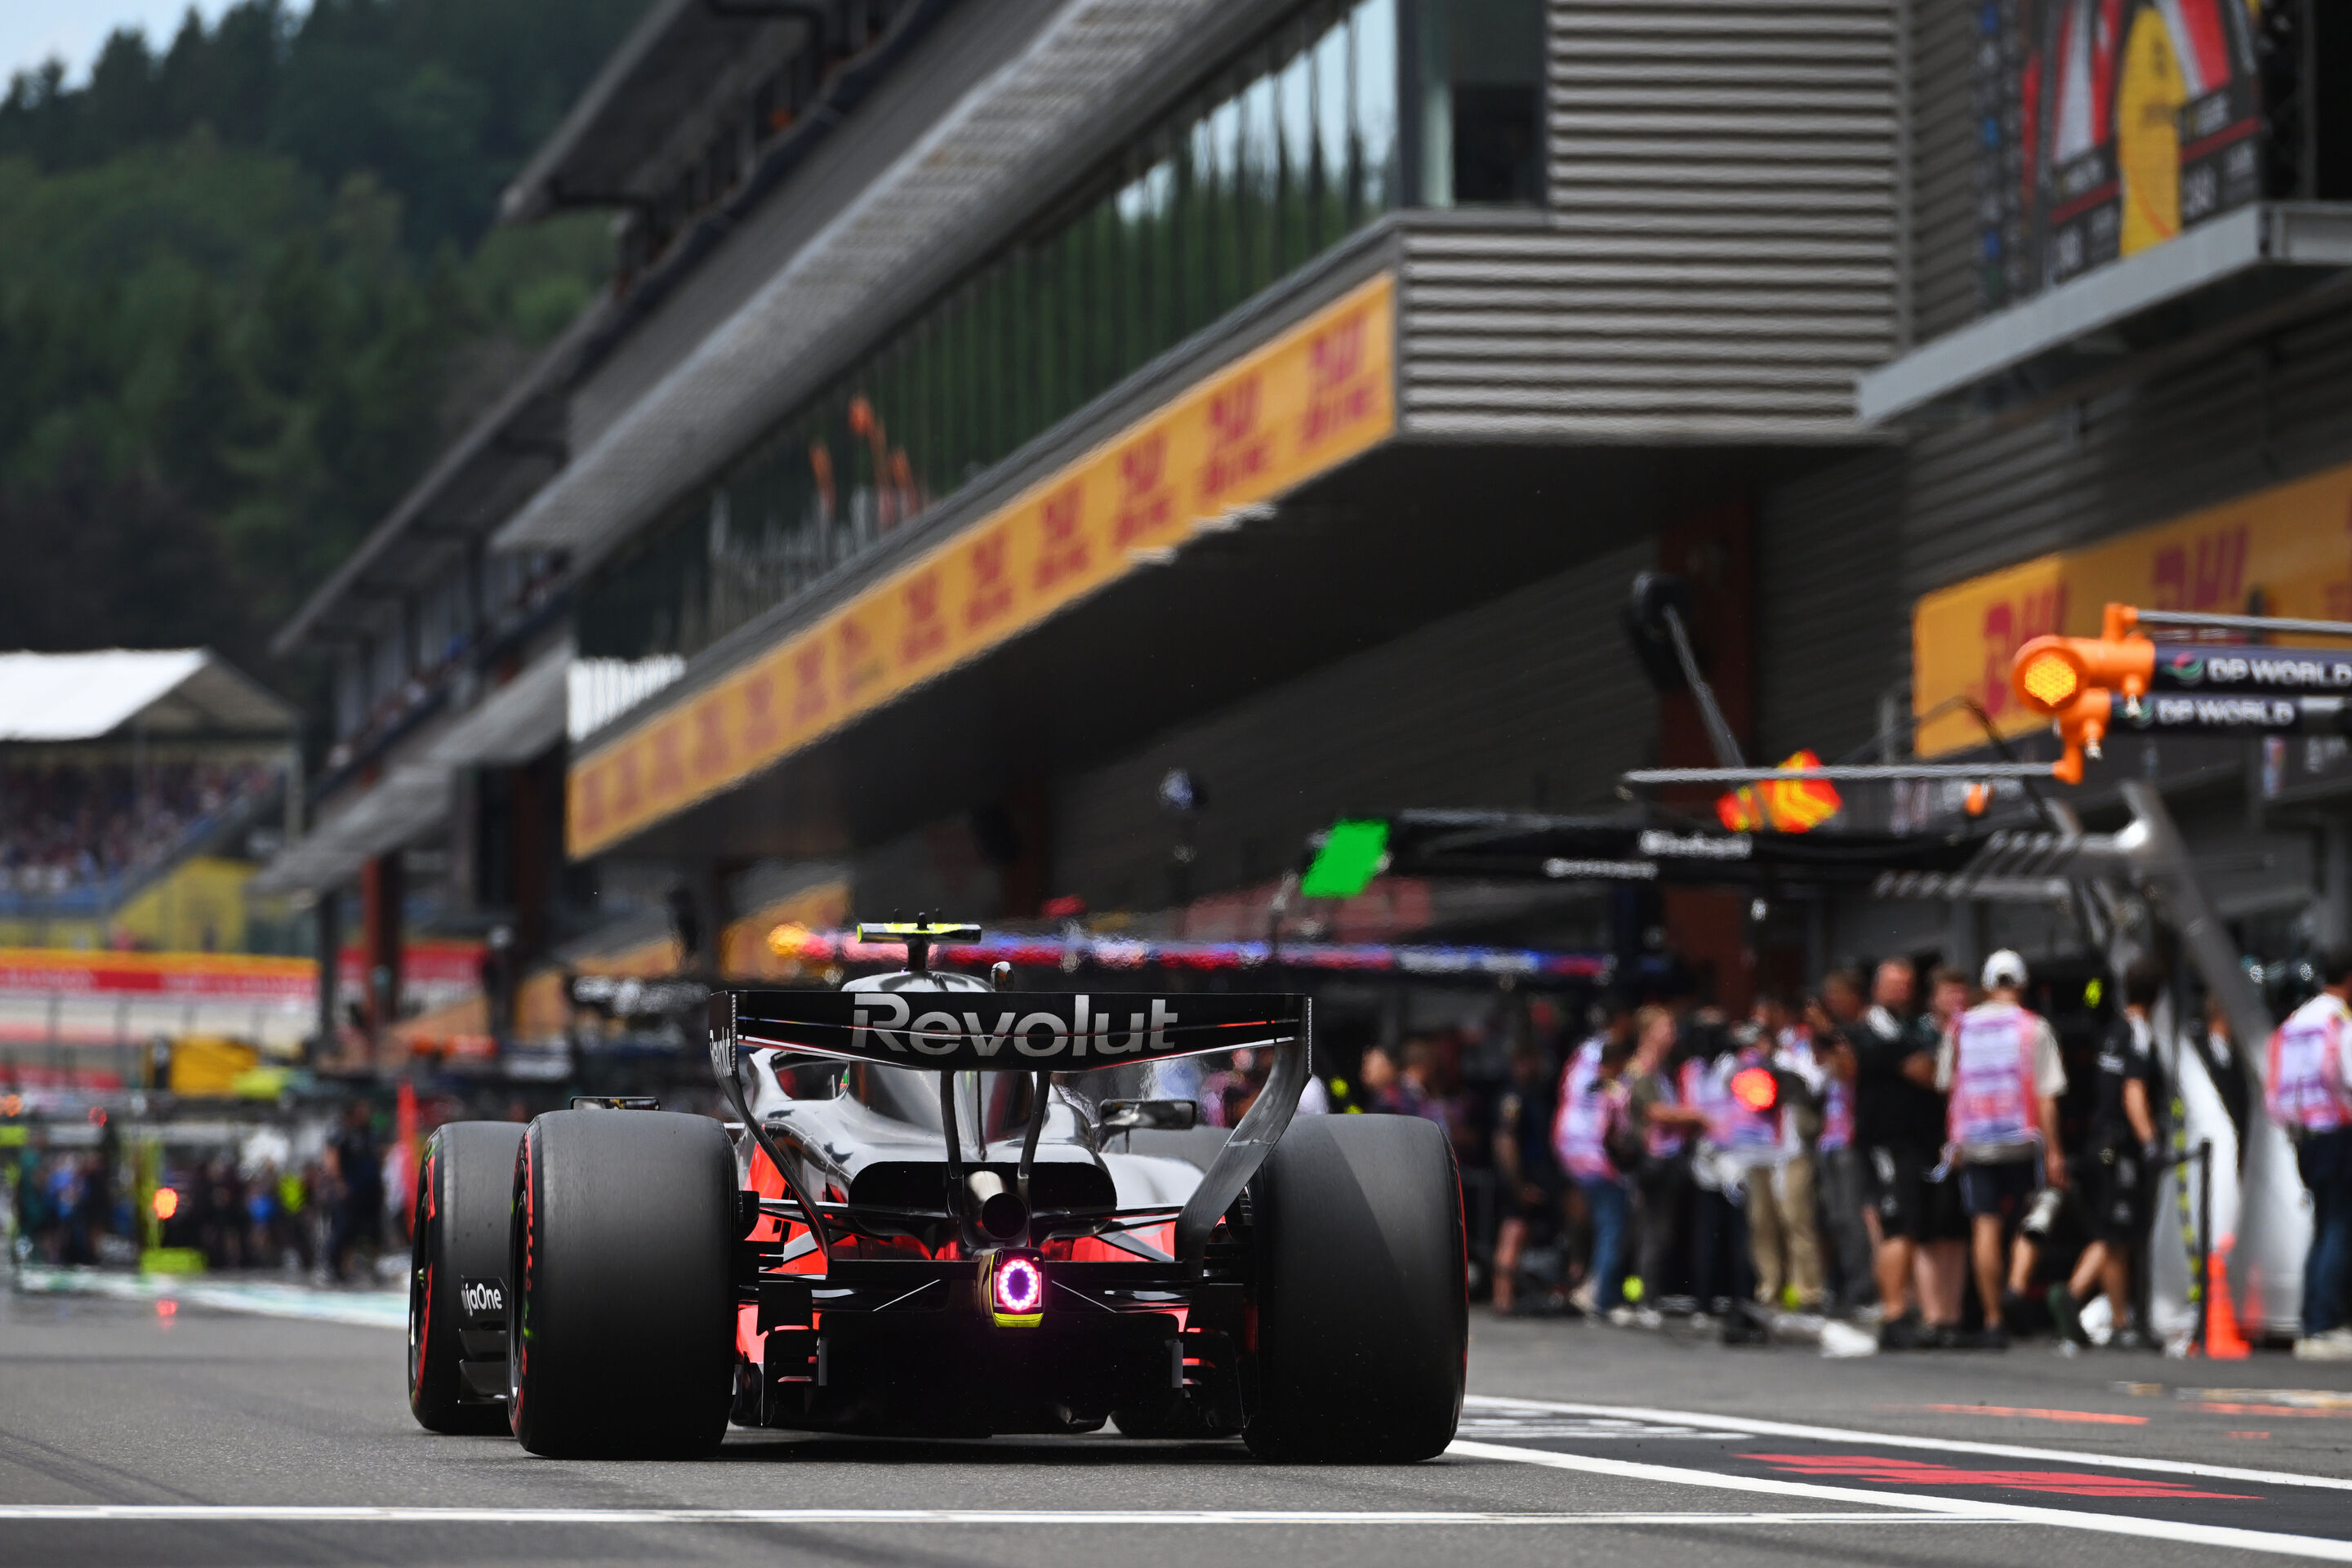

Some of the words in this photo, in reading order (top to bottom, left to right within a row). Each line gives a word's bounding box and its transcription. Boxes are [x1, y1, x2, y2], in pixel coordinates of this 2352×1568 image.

[2207, 657, 2248, 683] DP
[2250, 660, 2352, 687] WORLD
[2157, 699, 2195, 725] DP
[2195, 700, 2295, 726] WORLD
[851, 993, 1178, 1057] Revolut
